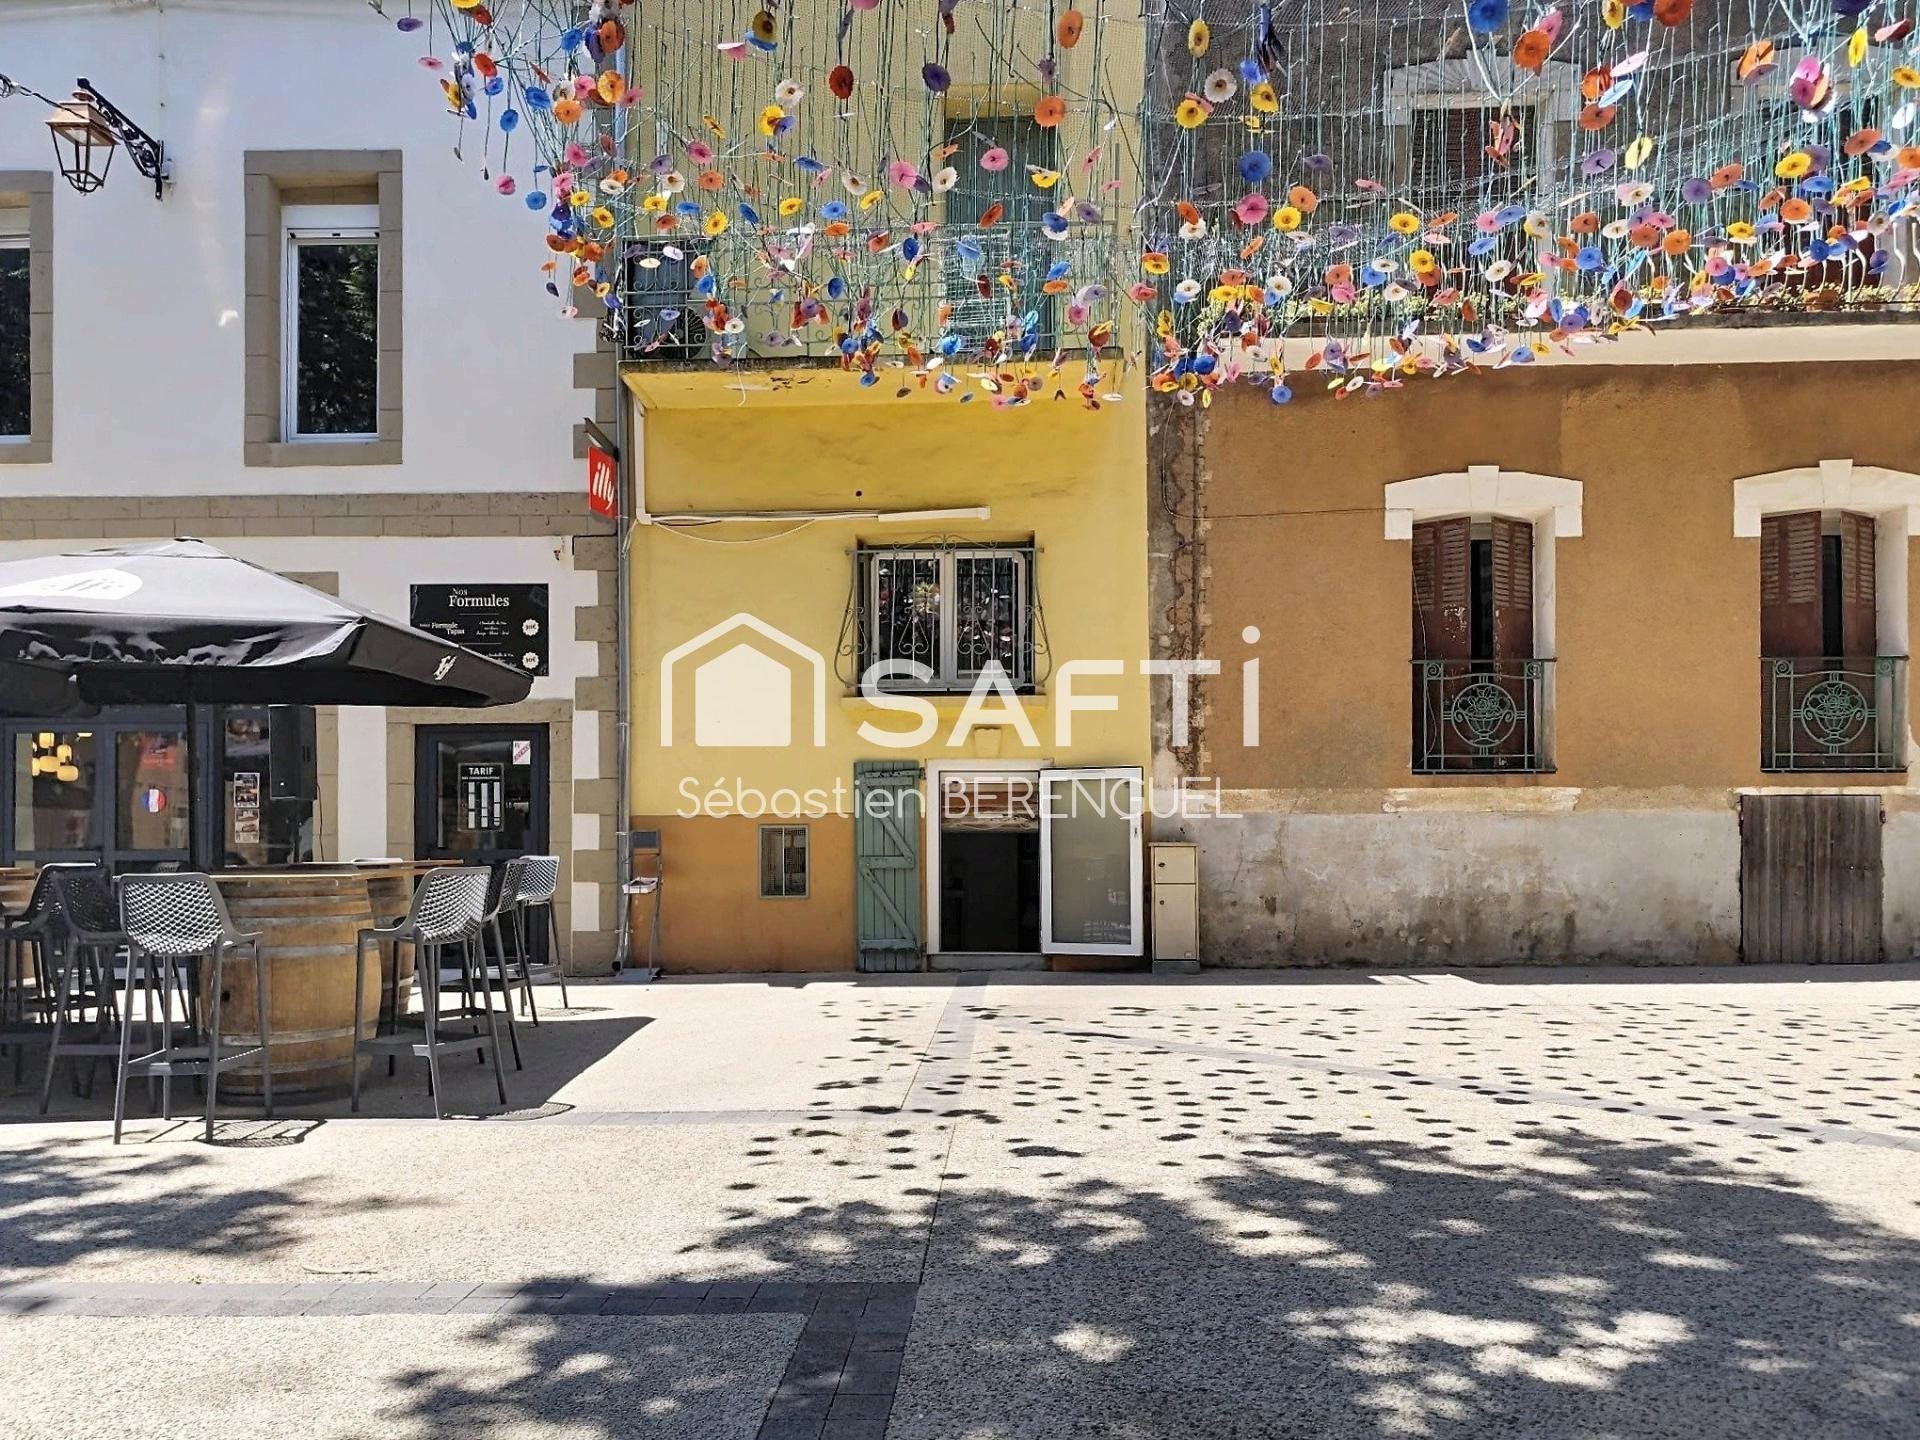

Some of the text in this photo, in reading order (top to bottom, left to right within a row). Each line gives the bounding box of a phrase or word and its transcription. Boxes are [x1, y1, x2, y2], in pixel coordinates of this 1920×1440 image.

[592, 461, 615, 511] illy
[452, 587, 468, 596] Nos
[448, 594, 510, 607] Formules
[468, 767, 494, 776] TARIF
